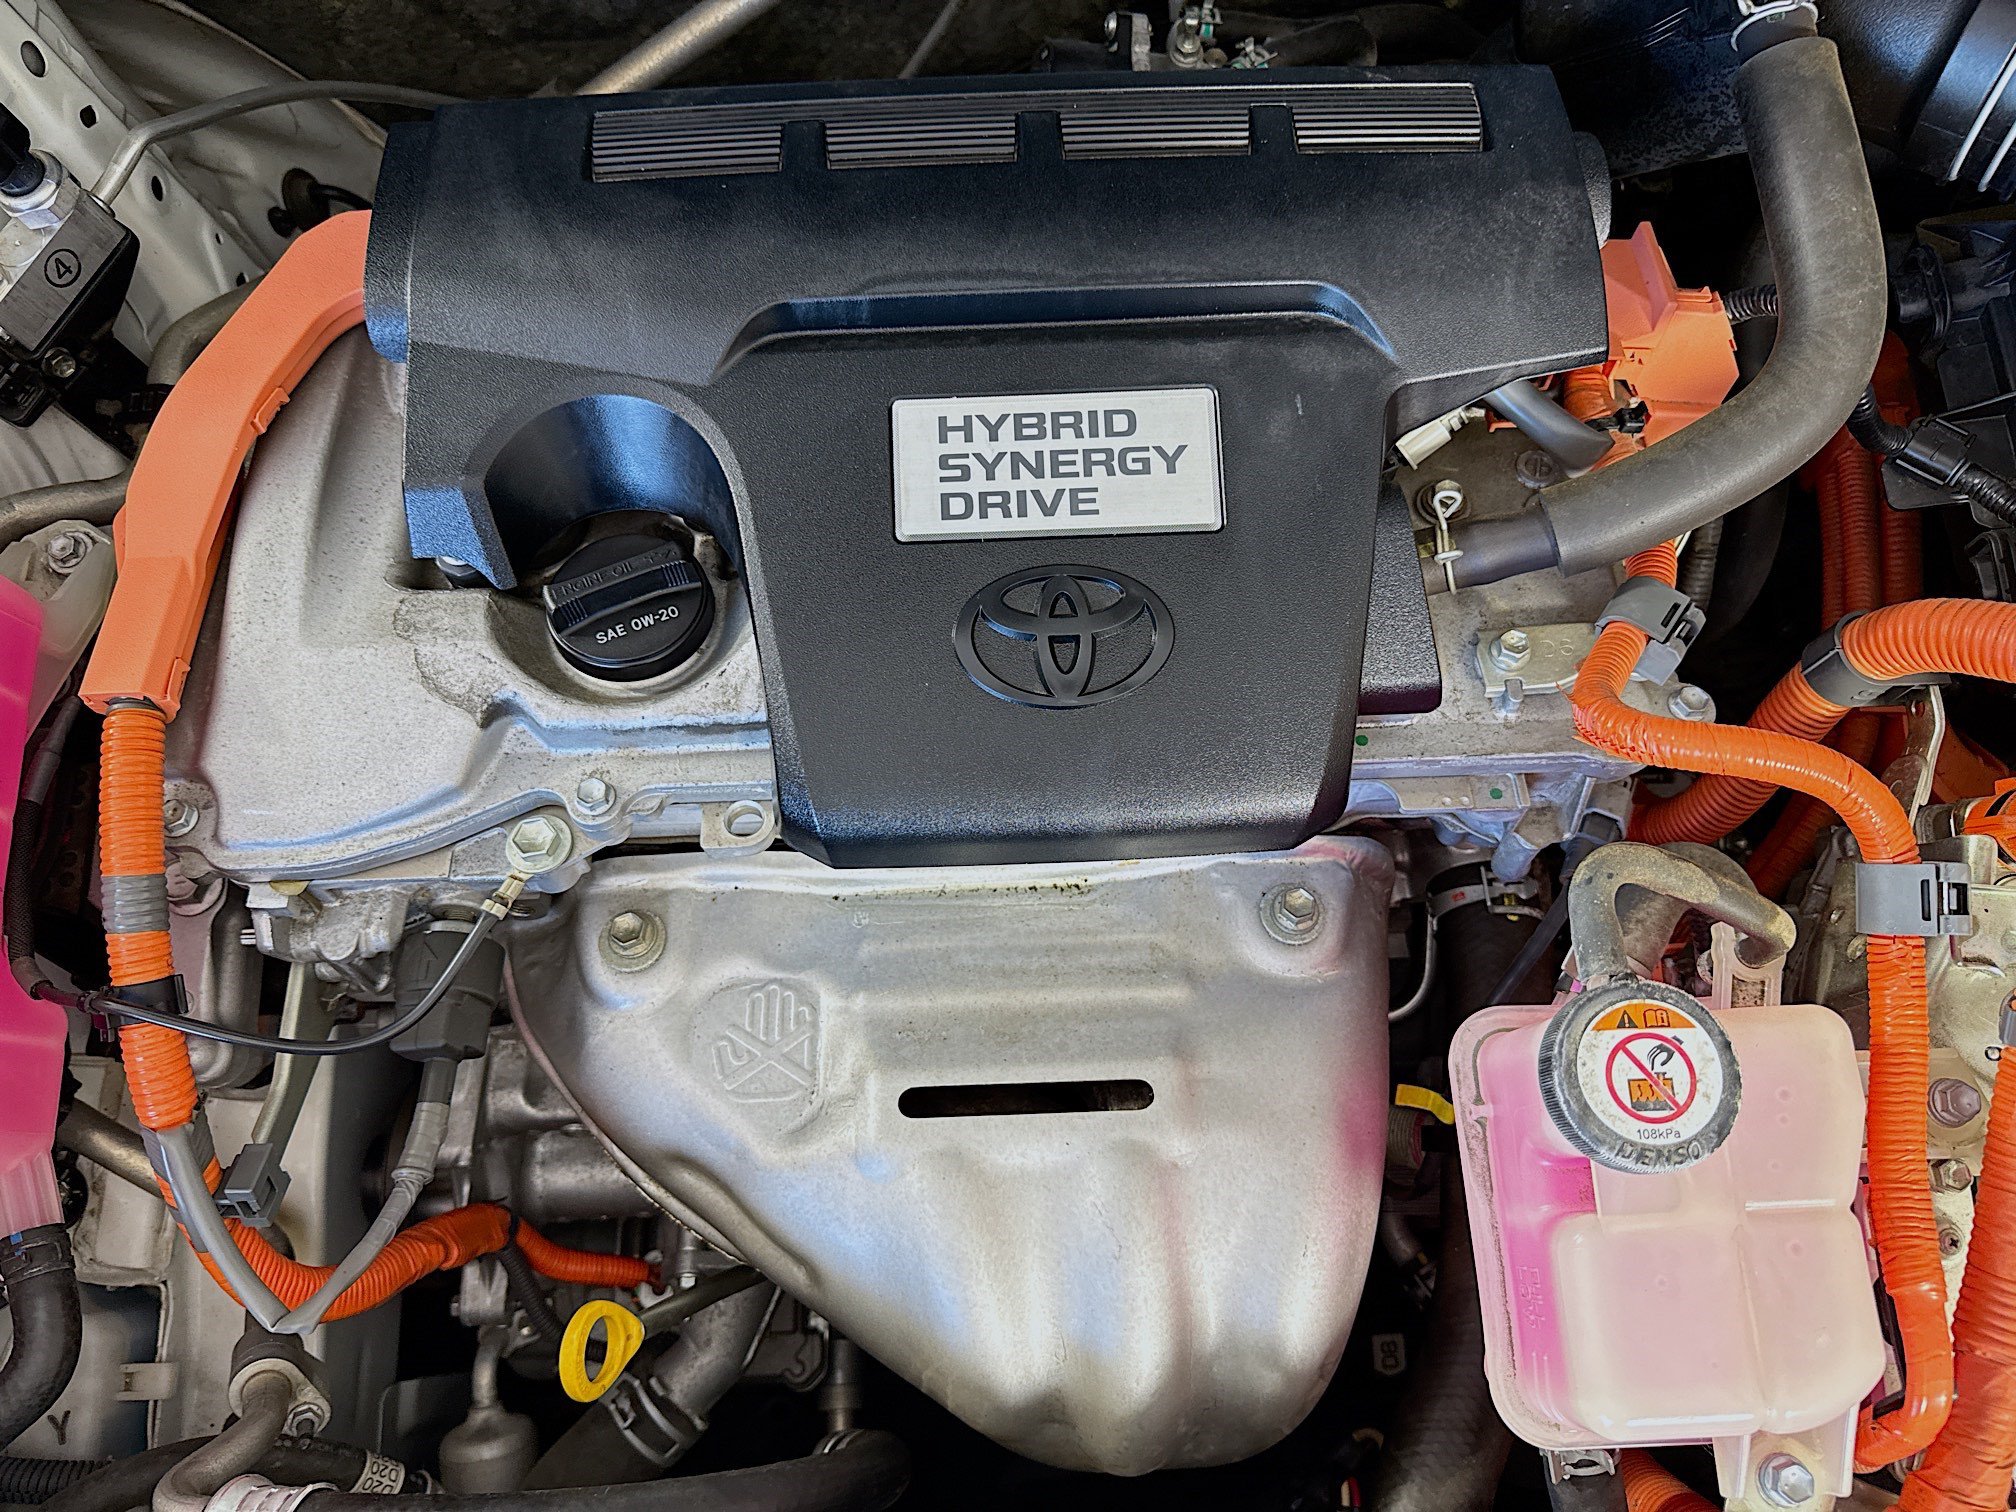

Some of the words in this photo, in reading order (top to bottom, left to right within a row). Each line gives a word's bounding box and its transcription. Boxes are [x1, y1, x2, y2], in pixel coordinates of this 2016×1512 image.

[938, 409, 1137, 444] HYBRID
[939, 444, 1188, 482] SYNERGY
[940, 487, 1100, 520] DRIVE
[595, 623, 628, 644] SAE
[631, 606, 679, 631] 0W-20
[1637, 1128, 1681, 1140] 108kPa
[1615, 1140, 1702, 1166] DENSO
[47, 1410, 71, 1445] Y
[371, 1461, 399, 1482] D20
